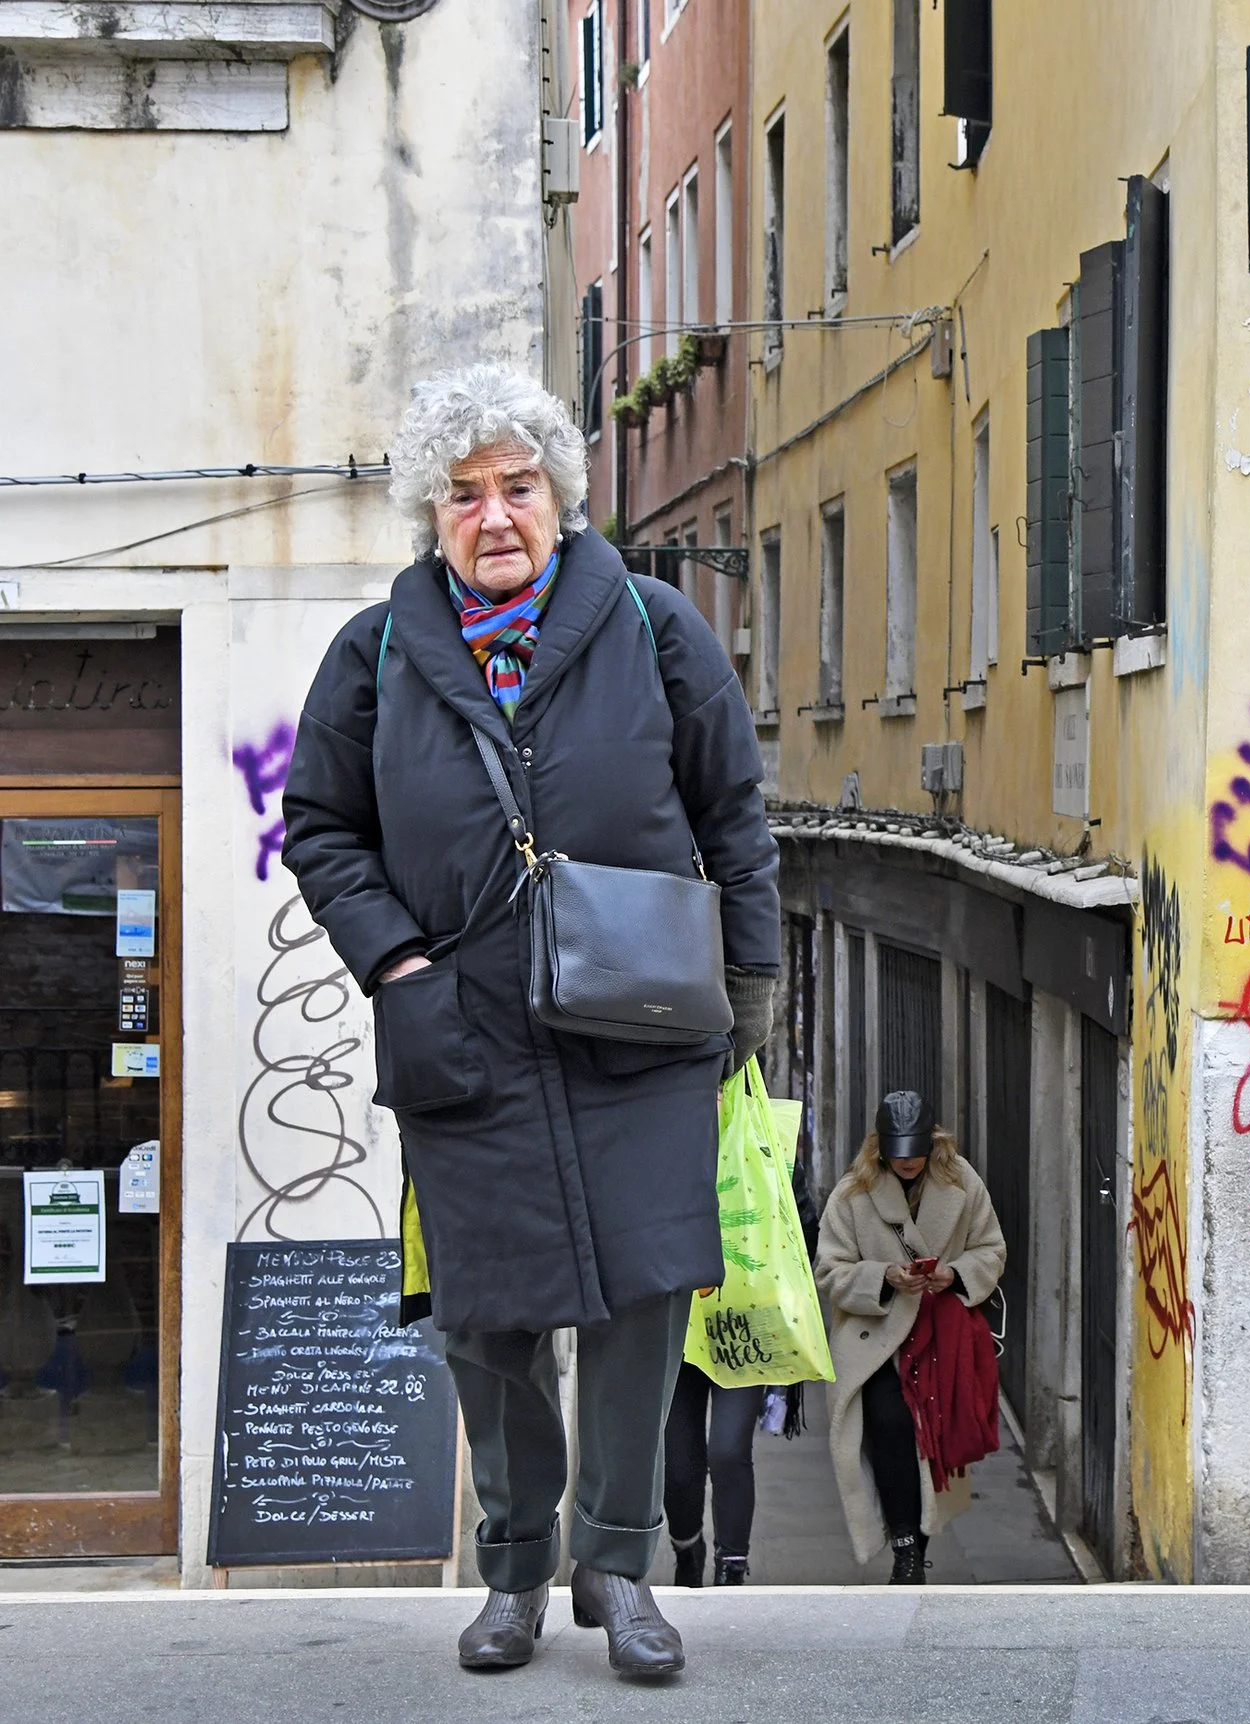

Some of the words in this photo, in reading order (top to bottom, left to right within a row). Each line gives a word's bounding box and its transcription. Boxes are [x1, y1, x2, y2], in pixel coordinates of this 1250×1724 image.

[249, 1271, 313, 1288] SPAGHETTI
[317, 1275, 344, 1286] ALLE
[347, 1274, 386, 1286] VONGOLE
[248, 1292, 312, 1309] SPAGHETTI
[334, 1292, 361, 1306] NERO
[376, 1292, 400, 1308] SE
[705, 1307, 751, 1345] appy
[244, 1401, 310, 1415] SPAGHETTI
[312, 1401, 386, 1414] CARBONARA
[301, 1421, 341, 1436] PESTO
[245, 1455, 276, 1469] PETTO
[281, 1456, 299, 1468] DI
[302, 1455, 326, 1467] POLLO
